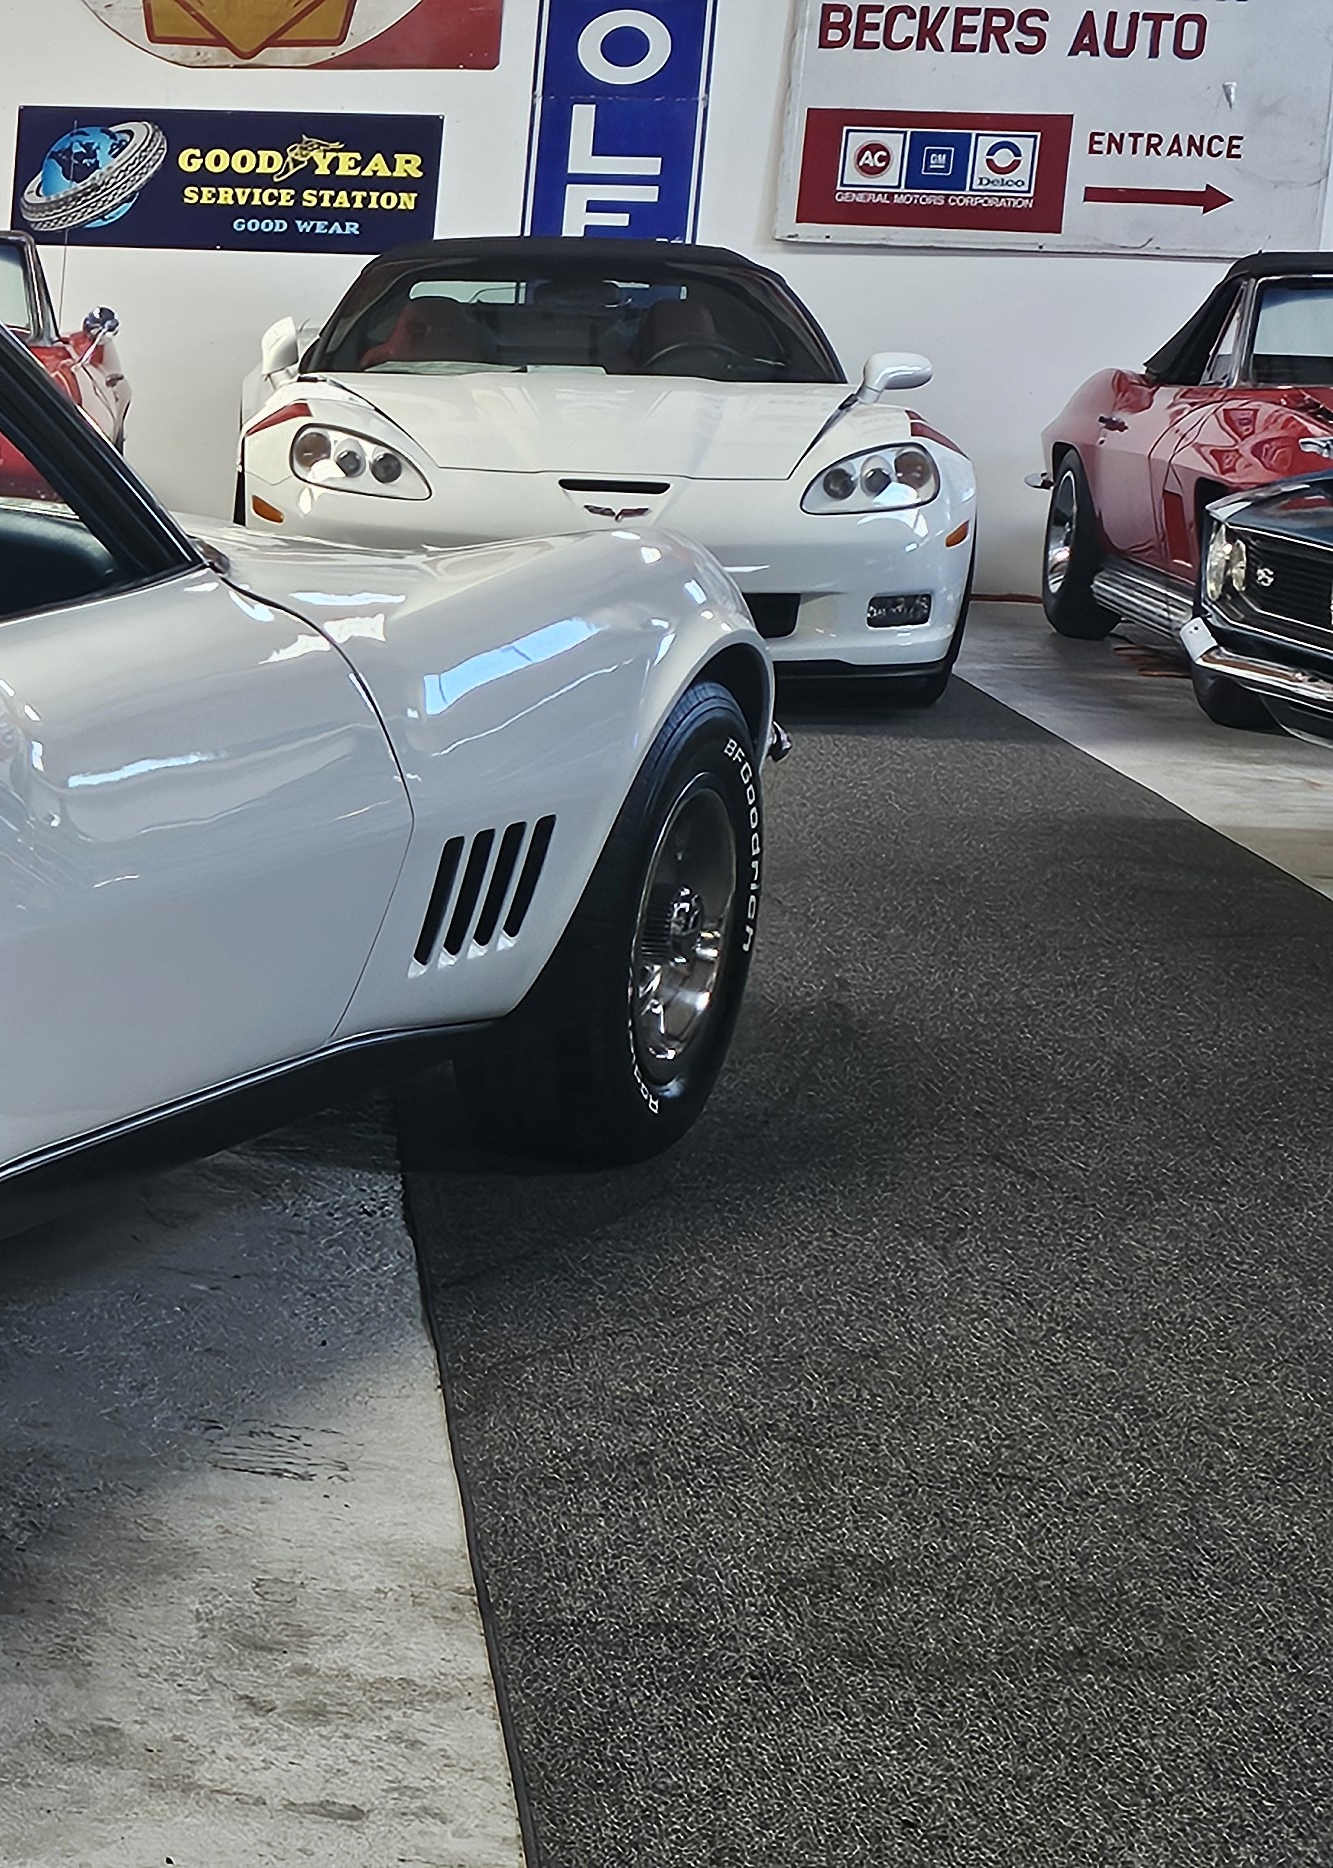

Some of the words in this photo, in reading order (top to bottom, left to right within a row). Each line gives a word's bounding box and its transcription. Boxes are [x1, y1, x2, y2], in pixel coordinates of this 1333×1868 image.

[818, 3, 1048, 55] BECKERS
[1068, 11, 1208, 59] AUTO
[1087, 131, 1244, 160] ENTRANCE
[858, 150, 888, 167] AC
[929, 153, 947, 165] GM
[978, 176, 1026, 188] Delco
[183, 186, 295, 207] SERVICE
[302, 189, 418, 210] STATION
[835, 191, 890, 204] GENERAL
[893, 194, 947, 206] MOTORS
[947, 195, 1033, 208] CORPORATION
[233, 218, 288, 233] GOOD
[295, 220, 360, 235] WEAR
